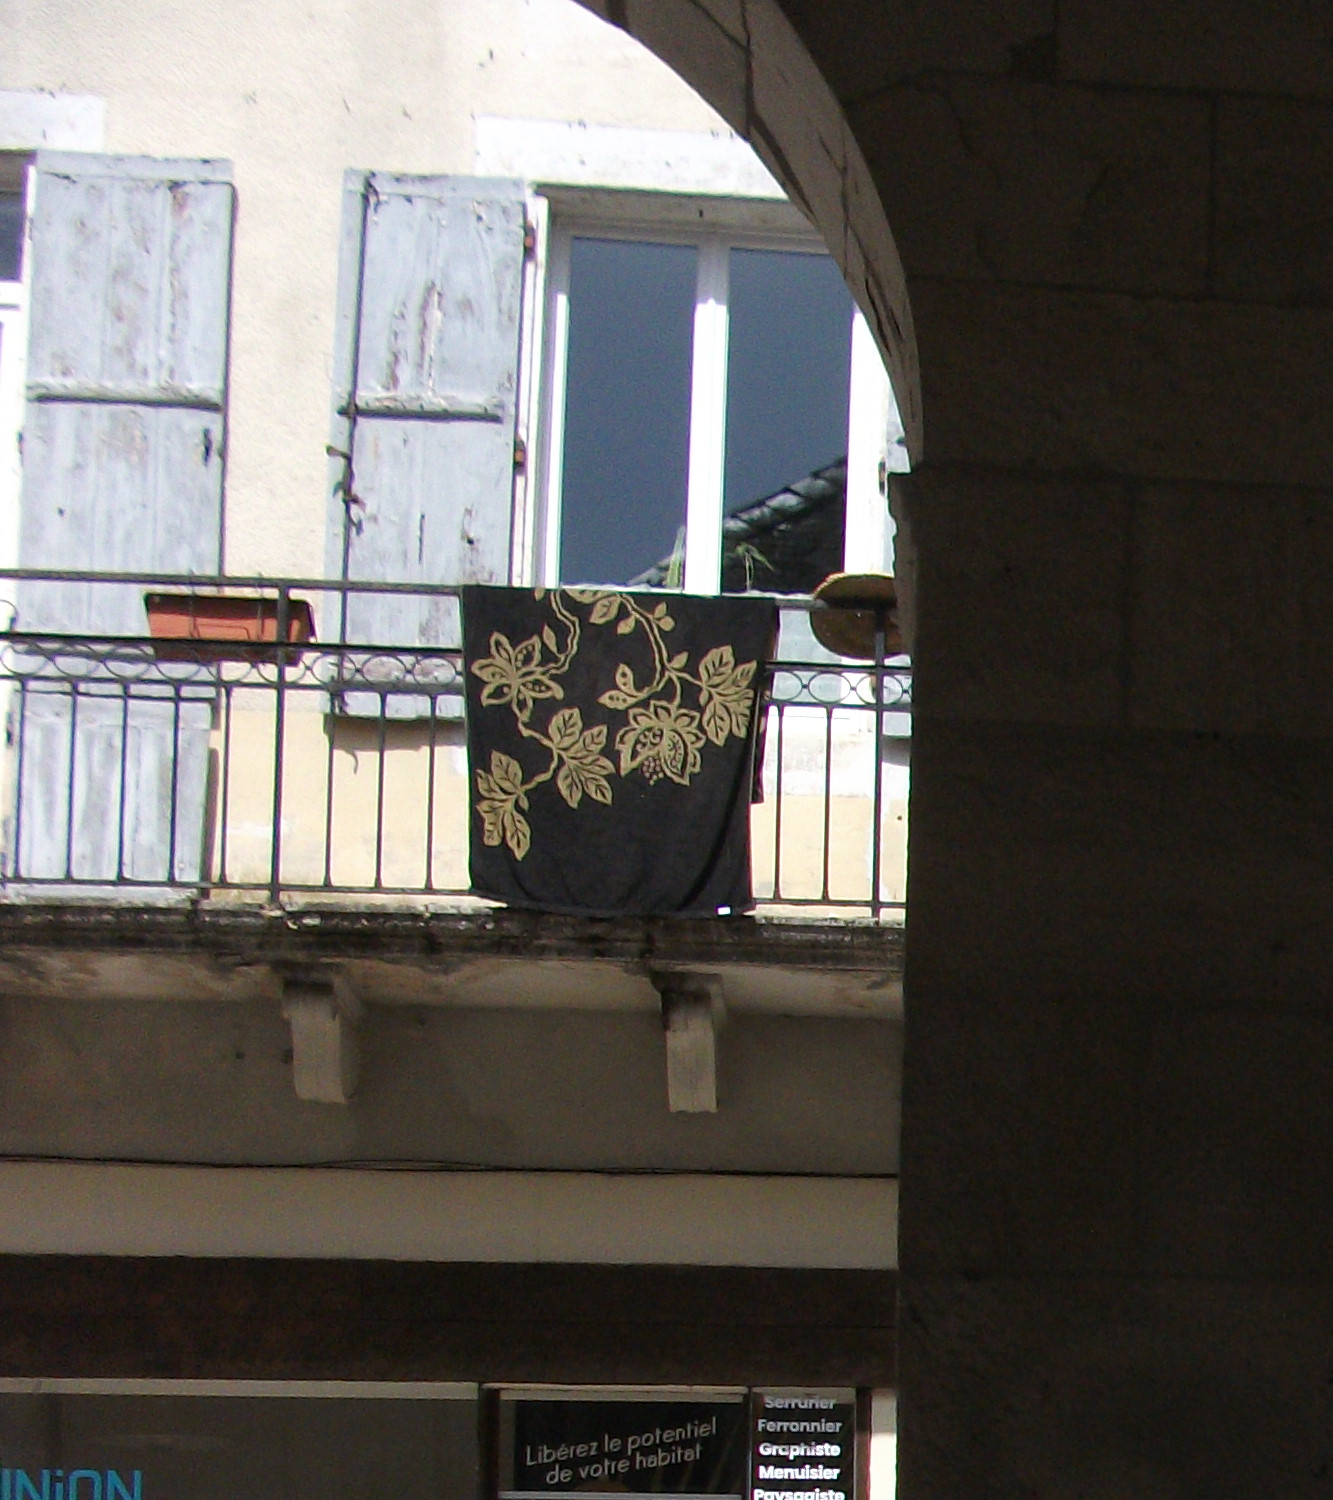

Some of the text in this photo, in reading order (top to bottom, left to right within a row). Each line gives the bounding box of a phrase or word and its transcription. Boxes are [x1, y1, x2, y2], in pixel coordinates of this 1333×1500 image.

[764, 1395, 837, 1409] Serrurier
[757, 1418, 842, 1433] Ferronnier
[525, 1416, 717, 1467] Libérez le potentiel
[759, 1442, 841, 1460] Graphiste
[546, 1443, 701, 1485] de votre habitat
[758, 1464, 841, 1480] Menuisier
